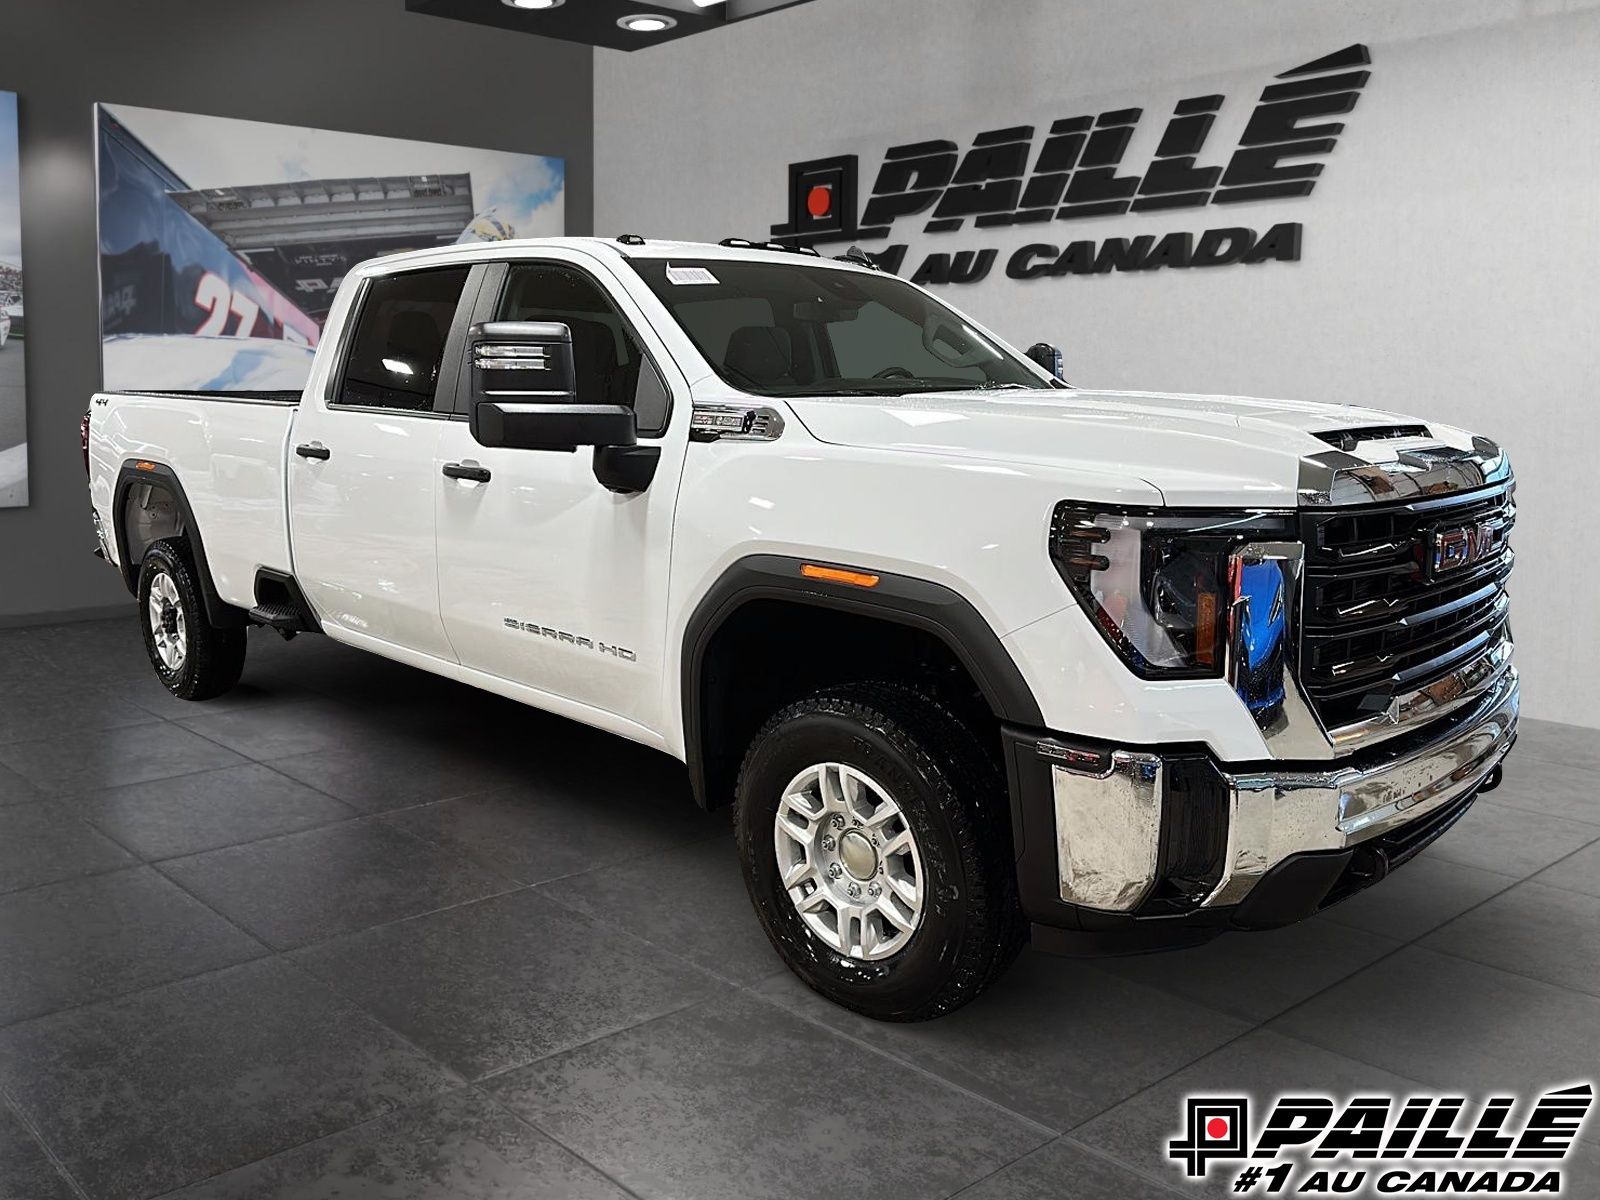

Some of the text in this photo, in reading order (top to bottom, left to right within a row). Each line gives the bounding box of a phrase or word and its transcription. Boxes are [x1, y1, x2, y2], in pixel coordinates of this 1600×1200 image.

[857, 43, 1372, 239] PAILLÉ
[909, 248, 999, 286] AU
[1005, 222, 1303, 280] CANADA
[504, 617, 637, 662] SIERRA HD
